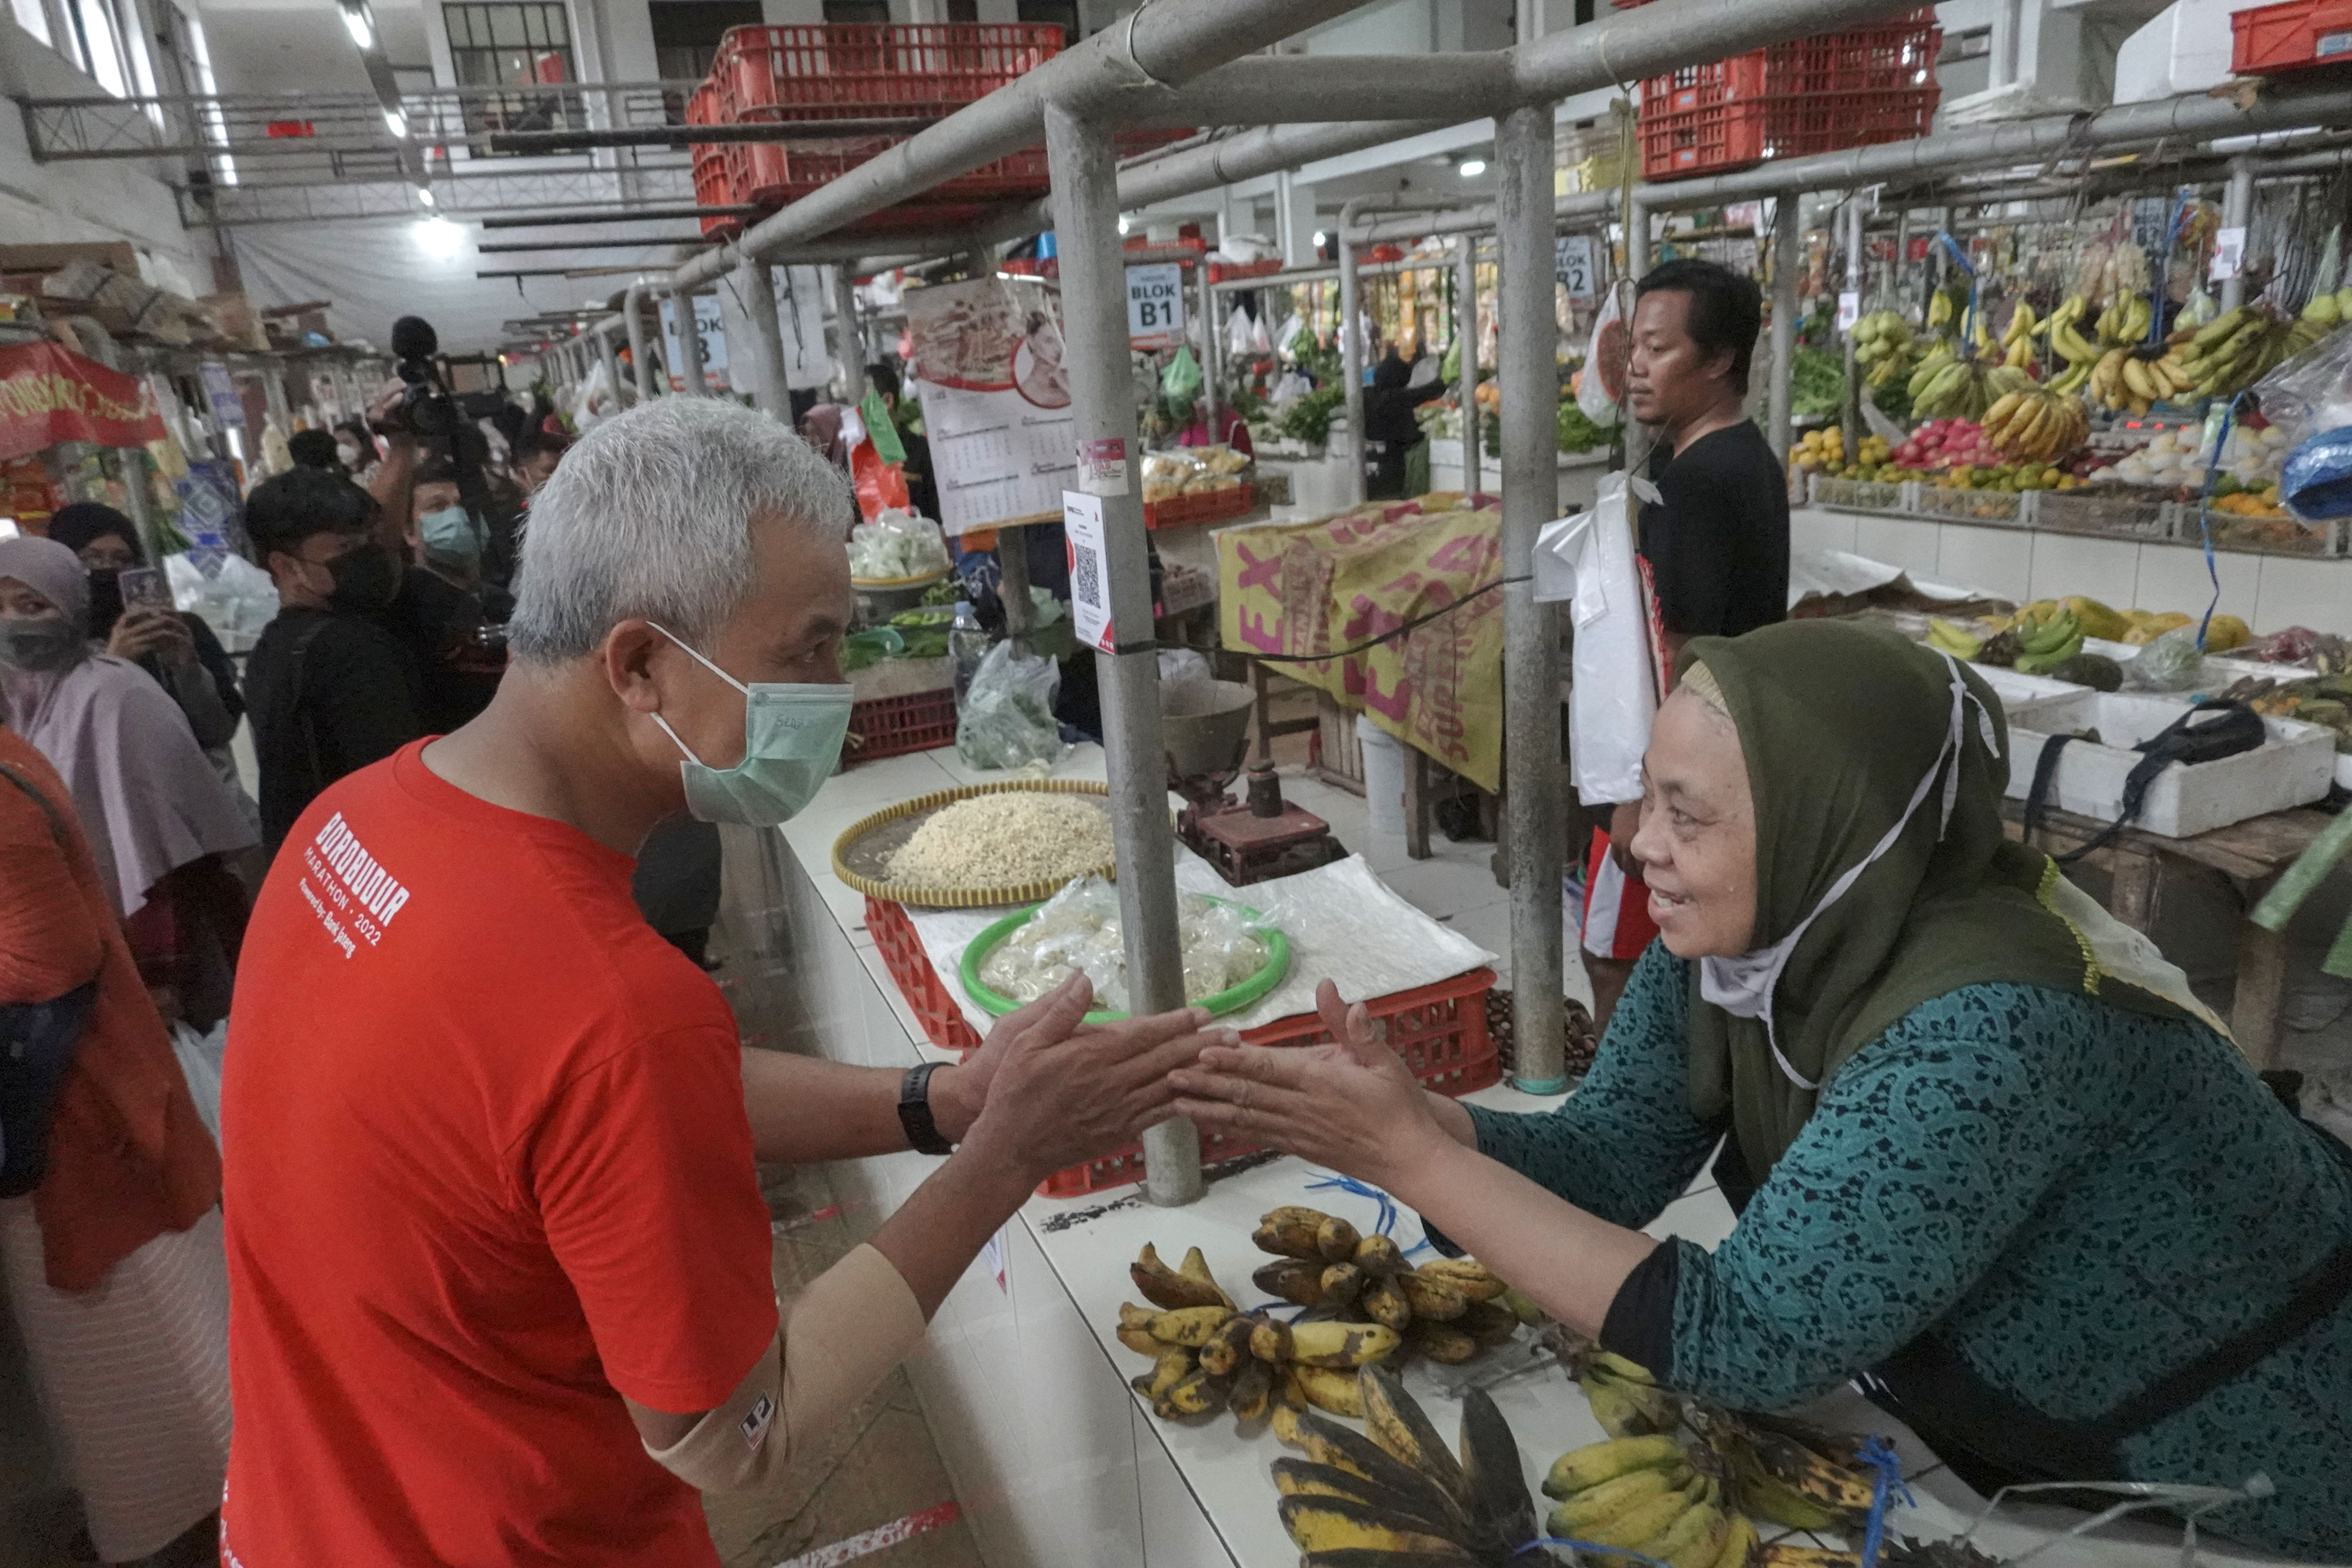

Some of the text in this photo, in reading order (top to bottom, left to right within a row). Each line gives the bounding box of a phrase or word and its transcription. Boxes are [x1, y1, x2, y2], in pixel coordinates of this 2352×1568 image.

[1559, 255, 1586, 267] LOK
[1132, 283, 1175, 299] BLOK
[1141, 300, 1171, 326] B1
[315, 811, 410, 927] BOROBUDUR
[299, 878, 322, 908] Powered
[323, 911, 340, 937] Bank
[304, 846, 381, 946] MARATHON 2022
